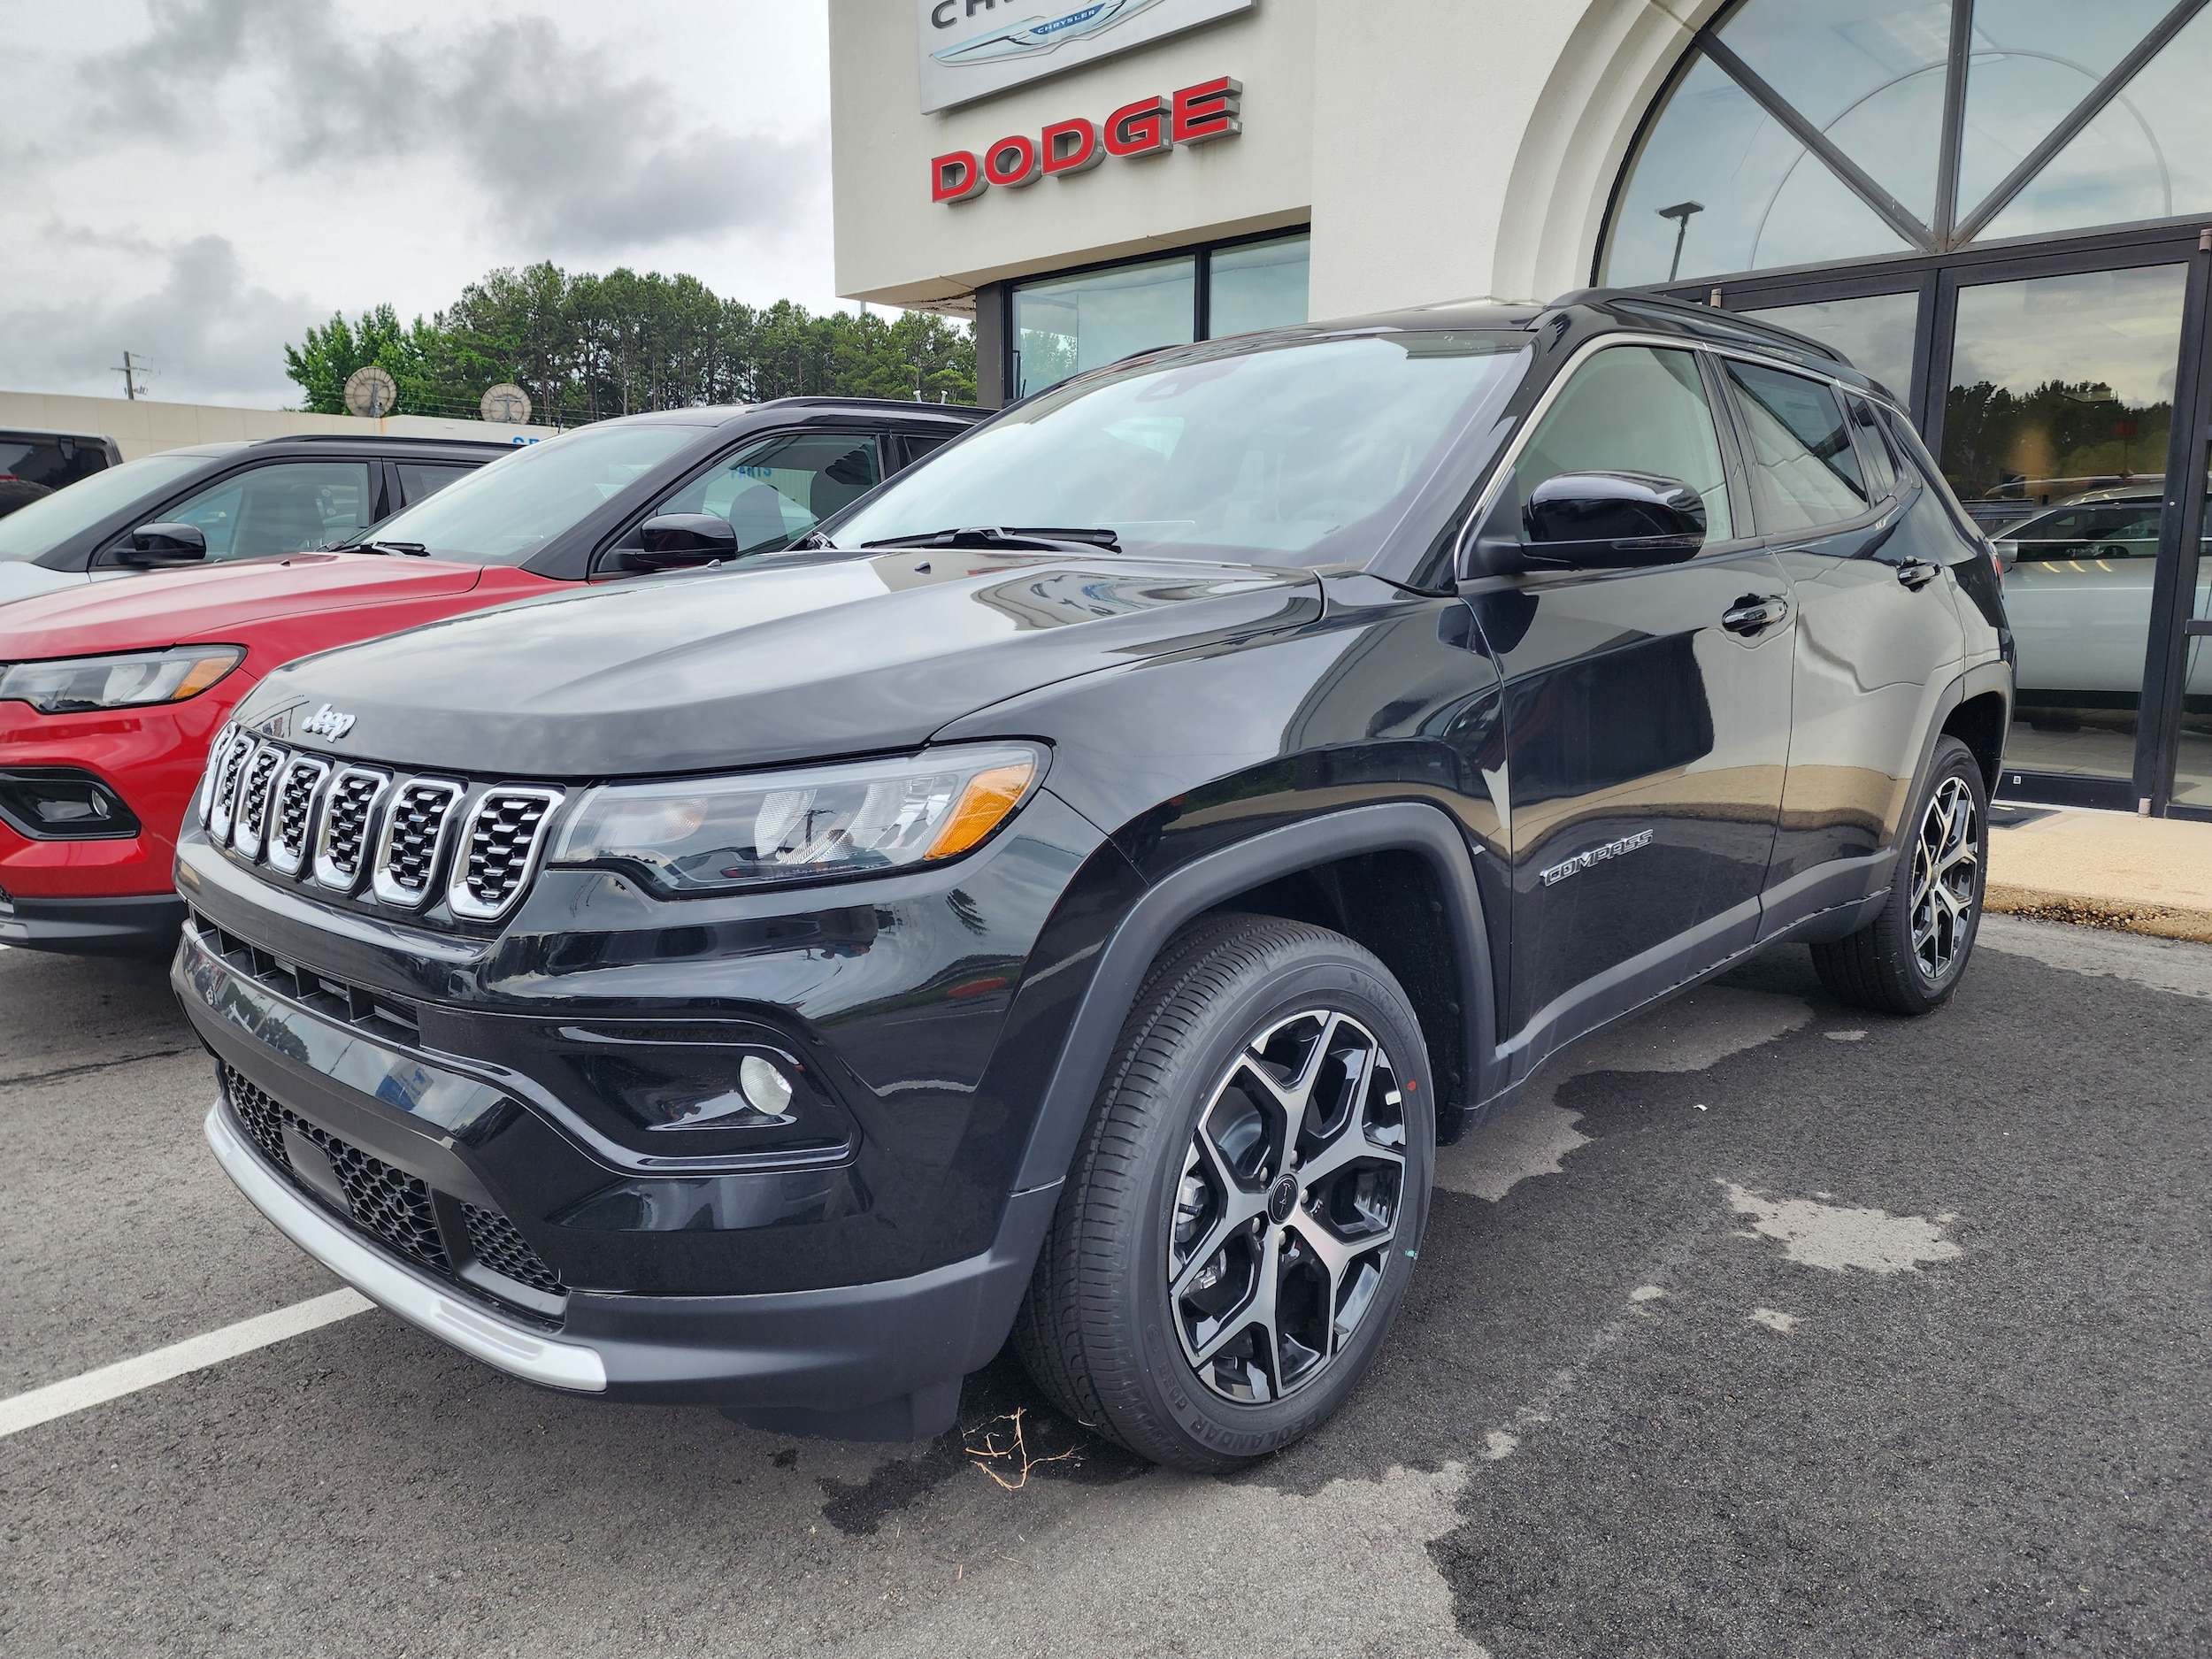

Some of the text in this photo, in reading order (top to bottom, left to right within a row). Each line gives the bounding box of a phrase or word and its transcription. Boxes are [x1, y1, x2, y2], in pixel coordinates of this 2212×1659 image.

[1037, 10, 1095, 34] CHRYSLER
[932, 76, 1242, 204] DODGE
[302, 703, 357, 743] Jeep
[1540, 828, 1654, 887] COMPASS
[1363, 977, 1410, 1042] YOKO
